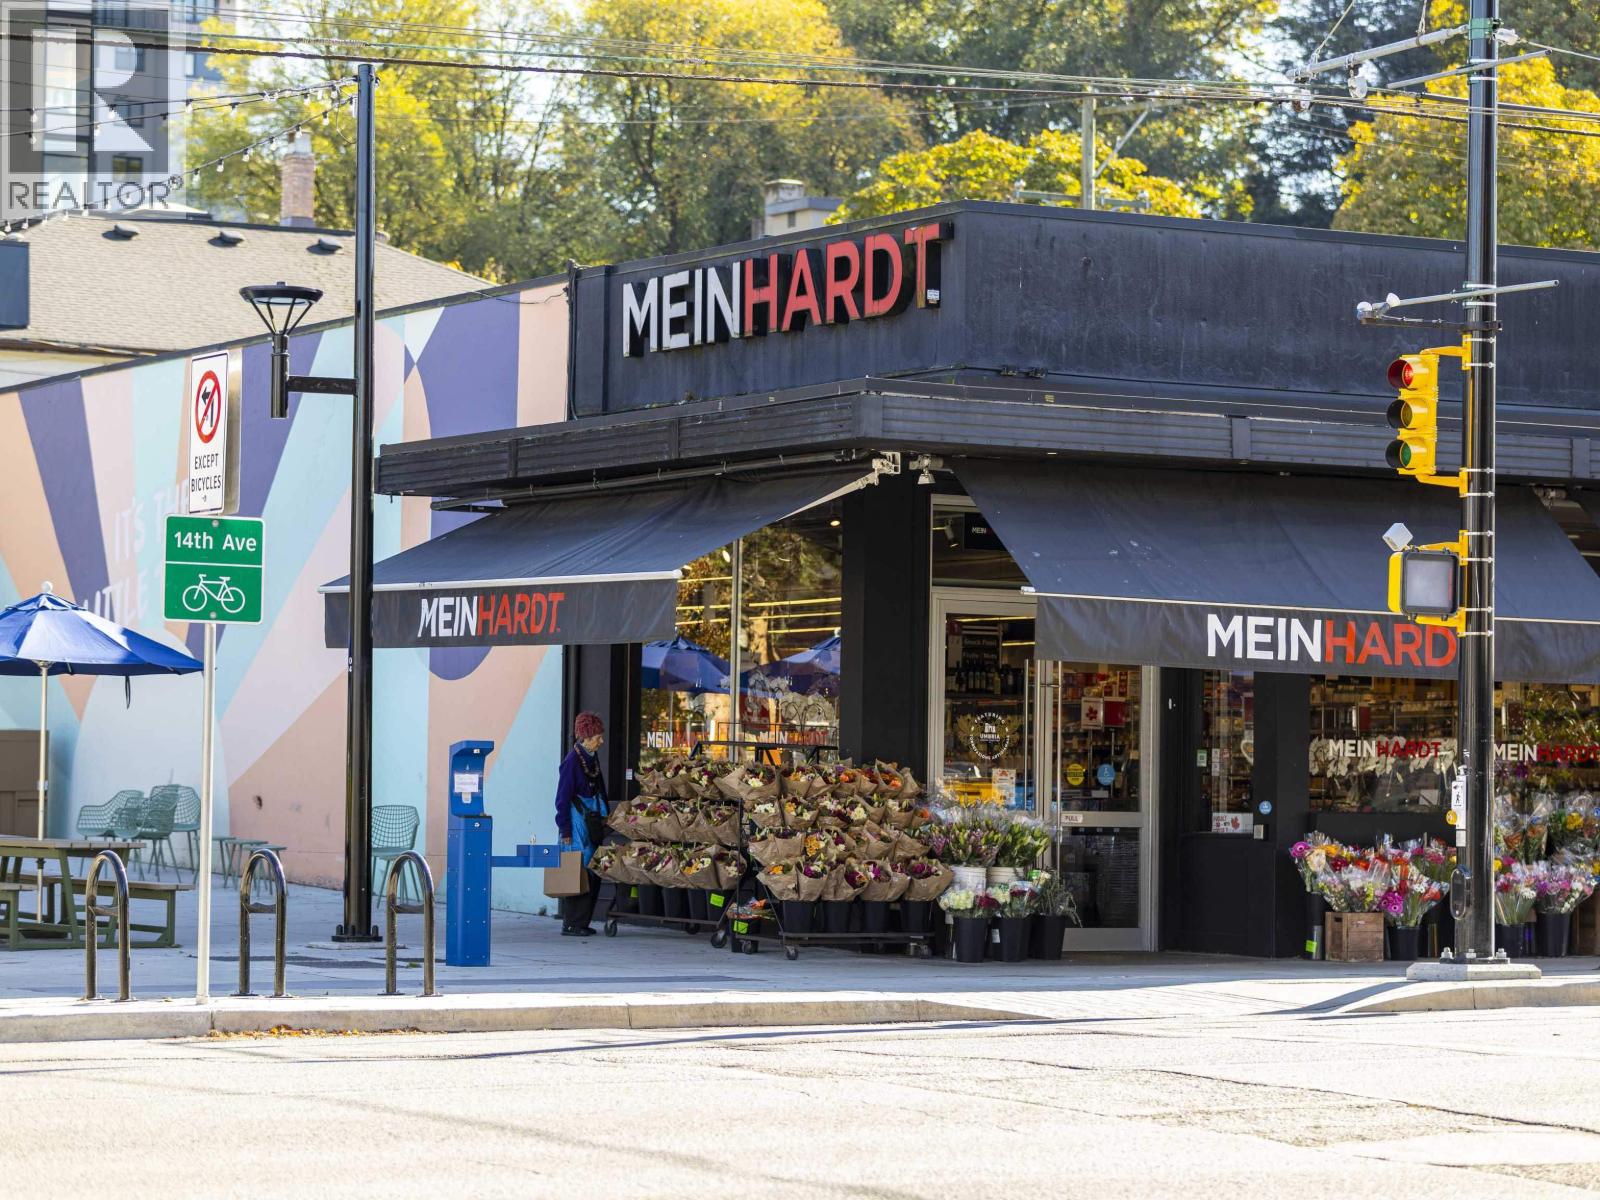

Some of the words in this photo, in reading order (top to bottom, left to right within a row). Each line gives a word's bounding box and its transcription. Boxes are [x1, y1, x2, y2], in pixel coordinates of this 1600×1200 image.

[622, 222, 941, 358] MEINHARDT
[194, 453, 219, 470] EXCEPT
[191, 474, 222, 493] BICYCLES
[174, 531, 213, 549] 14th
[222, 534, 257, 552] Ave
[417, 592, 565, 638] MEINHARDT
[1207, 613, 1458, 668] MEINHARD
[1328, 739, 1441, 759] MEINHARDT
